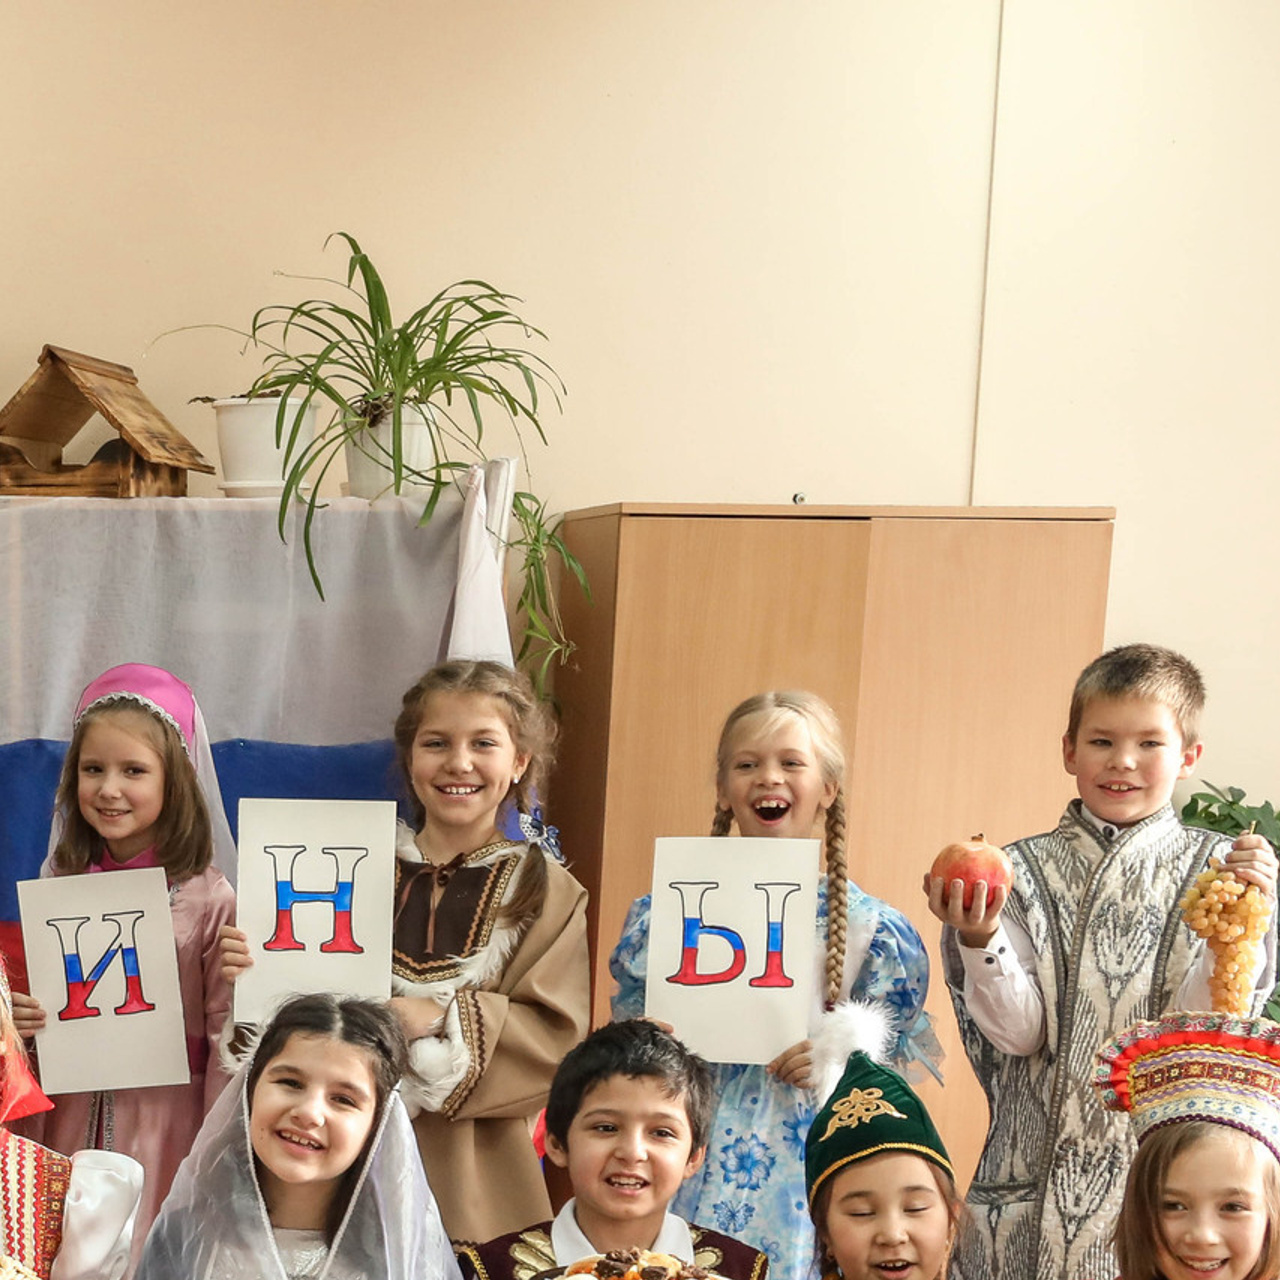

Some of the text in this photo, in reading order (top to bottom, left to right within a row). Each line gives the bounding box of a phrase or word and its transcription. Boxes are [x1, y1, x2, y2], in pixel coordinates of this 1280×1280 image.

[263, 845, 368, 954] Н
[665, 881, 801, 988] Ы
[46, 910, 156, 1021] И
